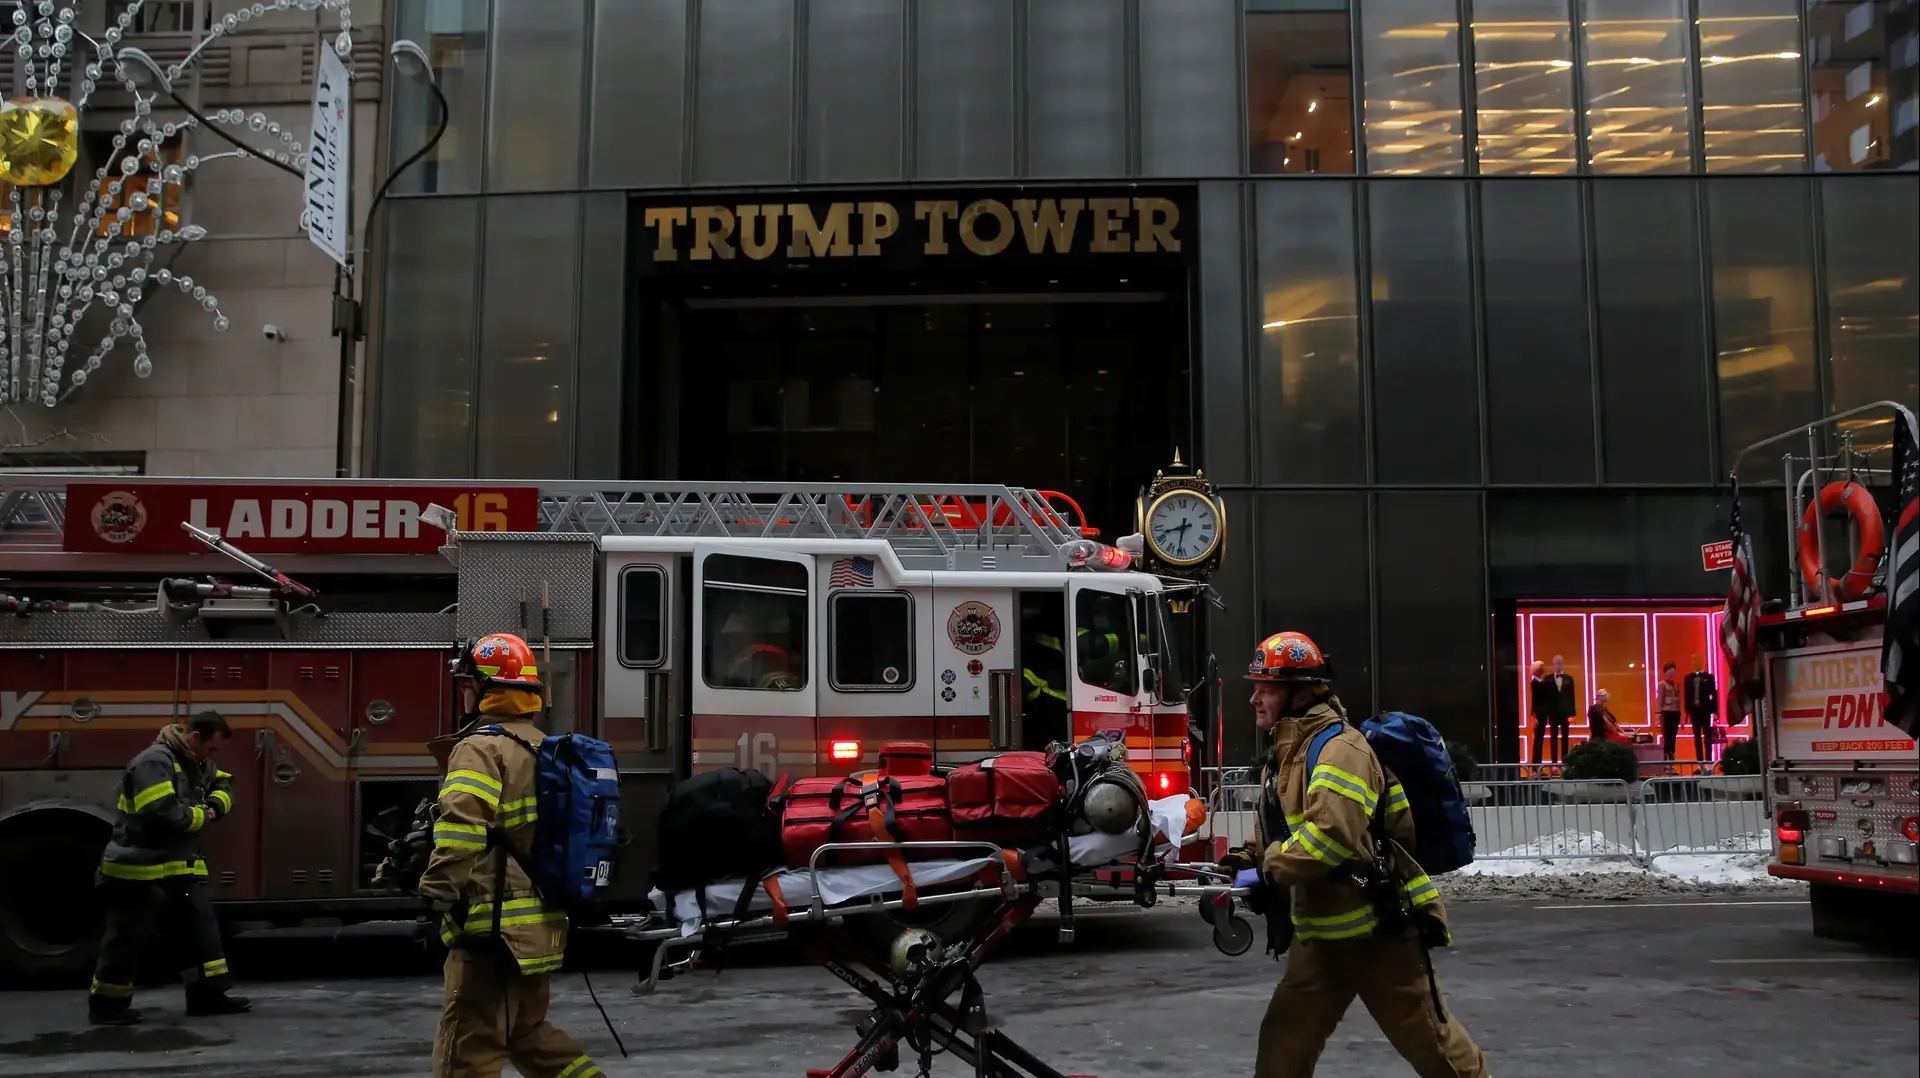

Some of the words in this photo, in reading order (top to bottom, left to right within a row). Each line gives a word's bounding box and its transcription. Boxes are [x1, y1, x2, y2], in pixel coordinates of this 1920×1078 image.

[309, 67, 331, 235] FINDLAY
[325, 125, 337, 241] GALLERIES
[644, 201, 900, 262] TRUMP
[914, 197, 1182, 257] TOWER
[189, 498, 420, 539] LADDER
[453, 493, 508, 532] 16
[1823, 692, 1888, 729] FDNY
[737, 732, 777, 784] 16
[1815, 742, 1837, 751] KEEP
[1840, 742, 1863, 751] BACK
[1866, 741, 1882, 750] 200
[1884, 740, 1909, 750] FEET
[825, 960, 868, 990] FDNY
[853, 1039, 886, 1074] FERNO
